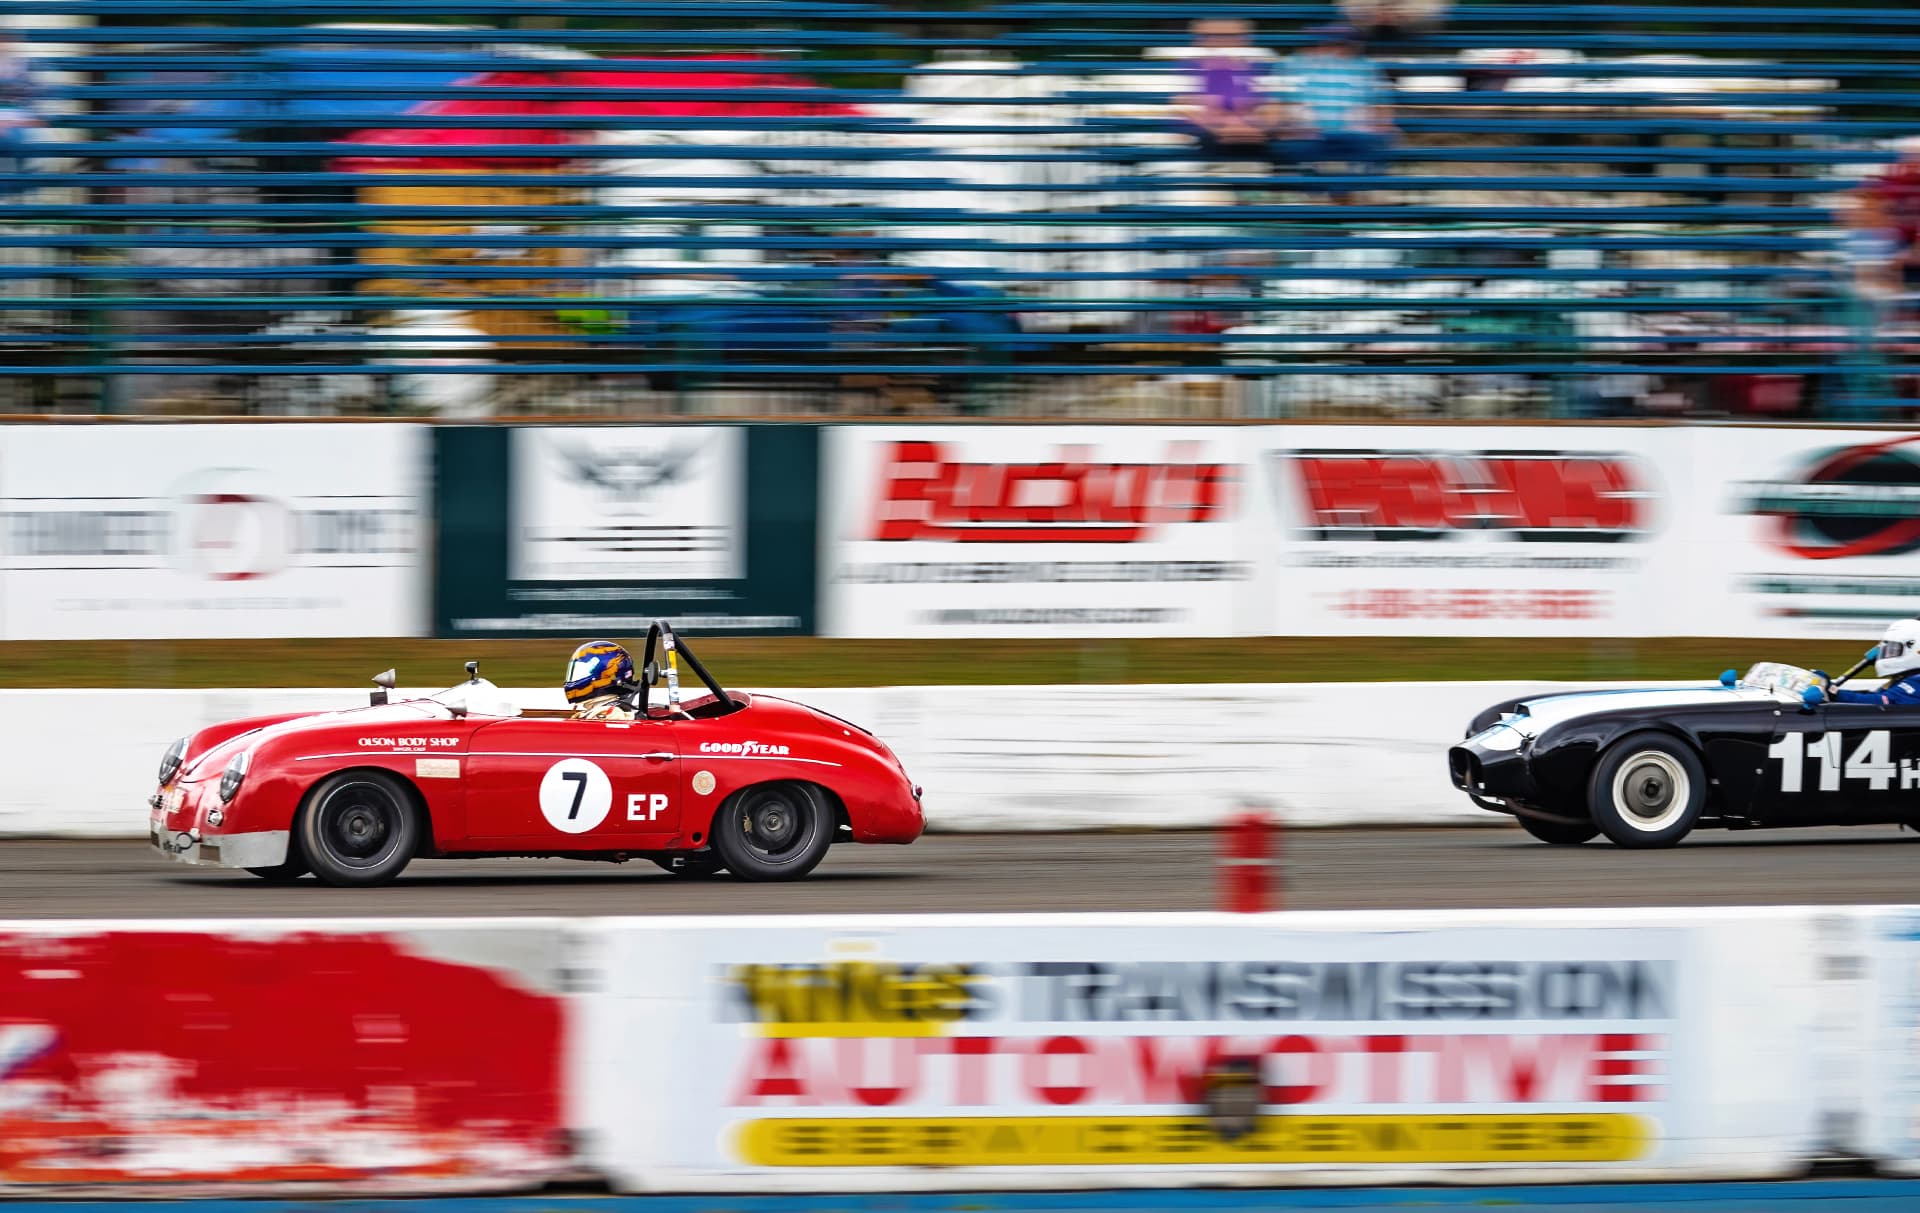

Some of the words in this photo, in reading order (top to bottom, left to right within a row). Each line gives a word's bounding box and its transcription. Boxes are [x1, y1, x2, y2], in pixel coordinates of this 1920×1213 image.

[358, 737, 396, 747] OLSON
[398, 737, 427, 747] BODY
[430, 737, 459, 747] SHOP
[700, 741, 790, 756] GOODYEAR
[1768, 730, 1897, 792] 114
[562, 772, 588, 820] 7
[627, 794, 669, 821] EP
[728, 1033, 1666, 1107] AUTOMOTIVE
